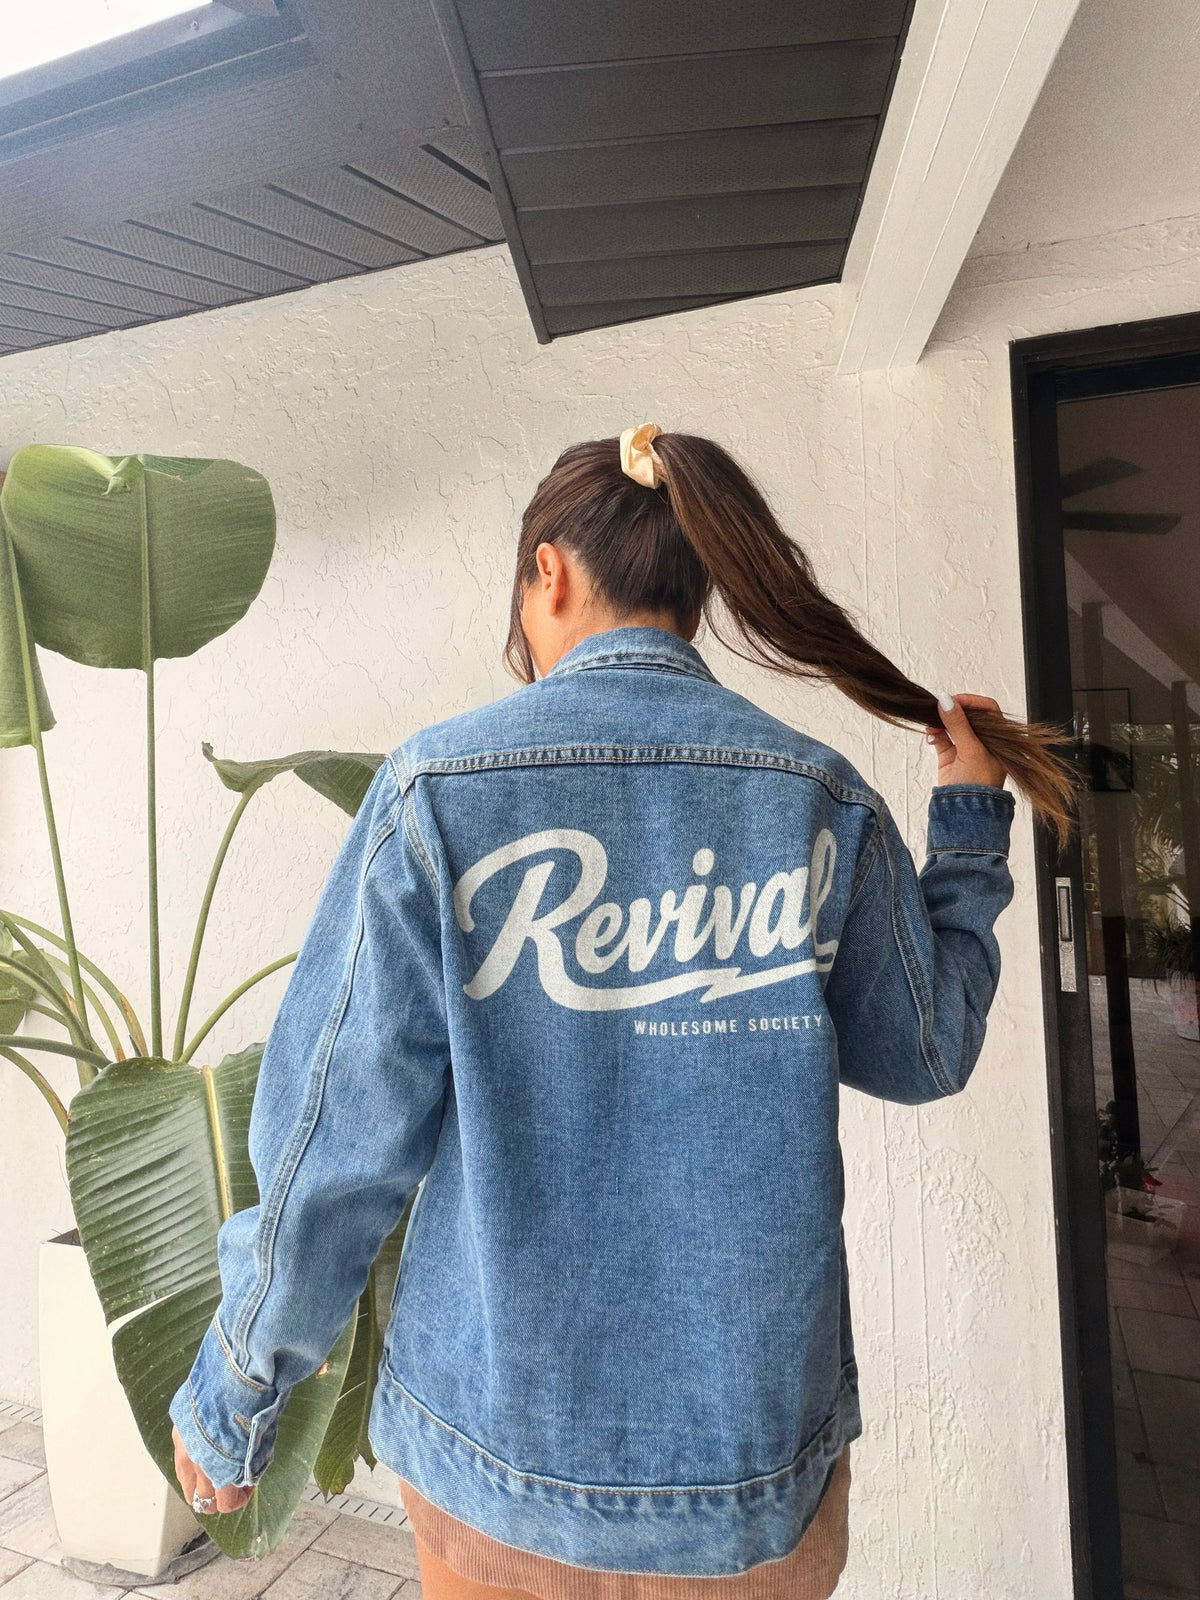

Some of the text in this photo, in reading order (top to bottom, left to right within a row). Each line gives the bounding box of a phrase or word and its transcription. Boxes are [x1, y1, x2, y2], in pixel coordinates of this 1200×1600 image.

[454, 828, 838, 1011] Revival
[633, 1014, 823, 1036] WHOLESOME SOCIETY
